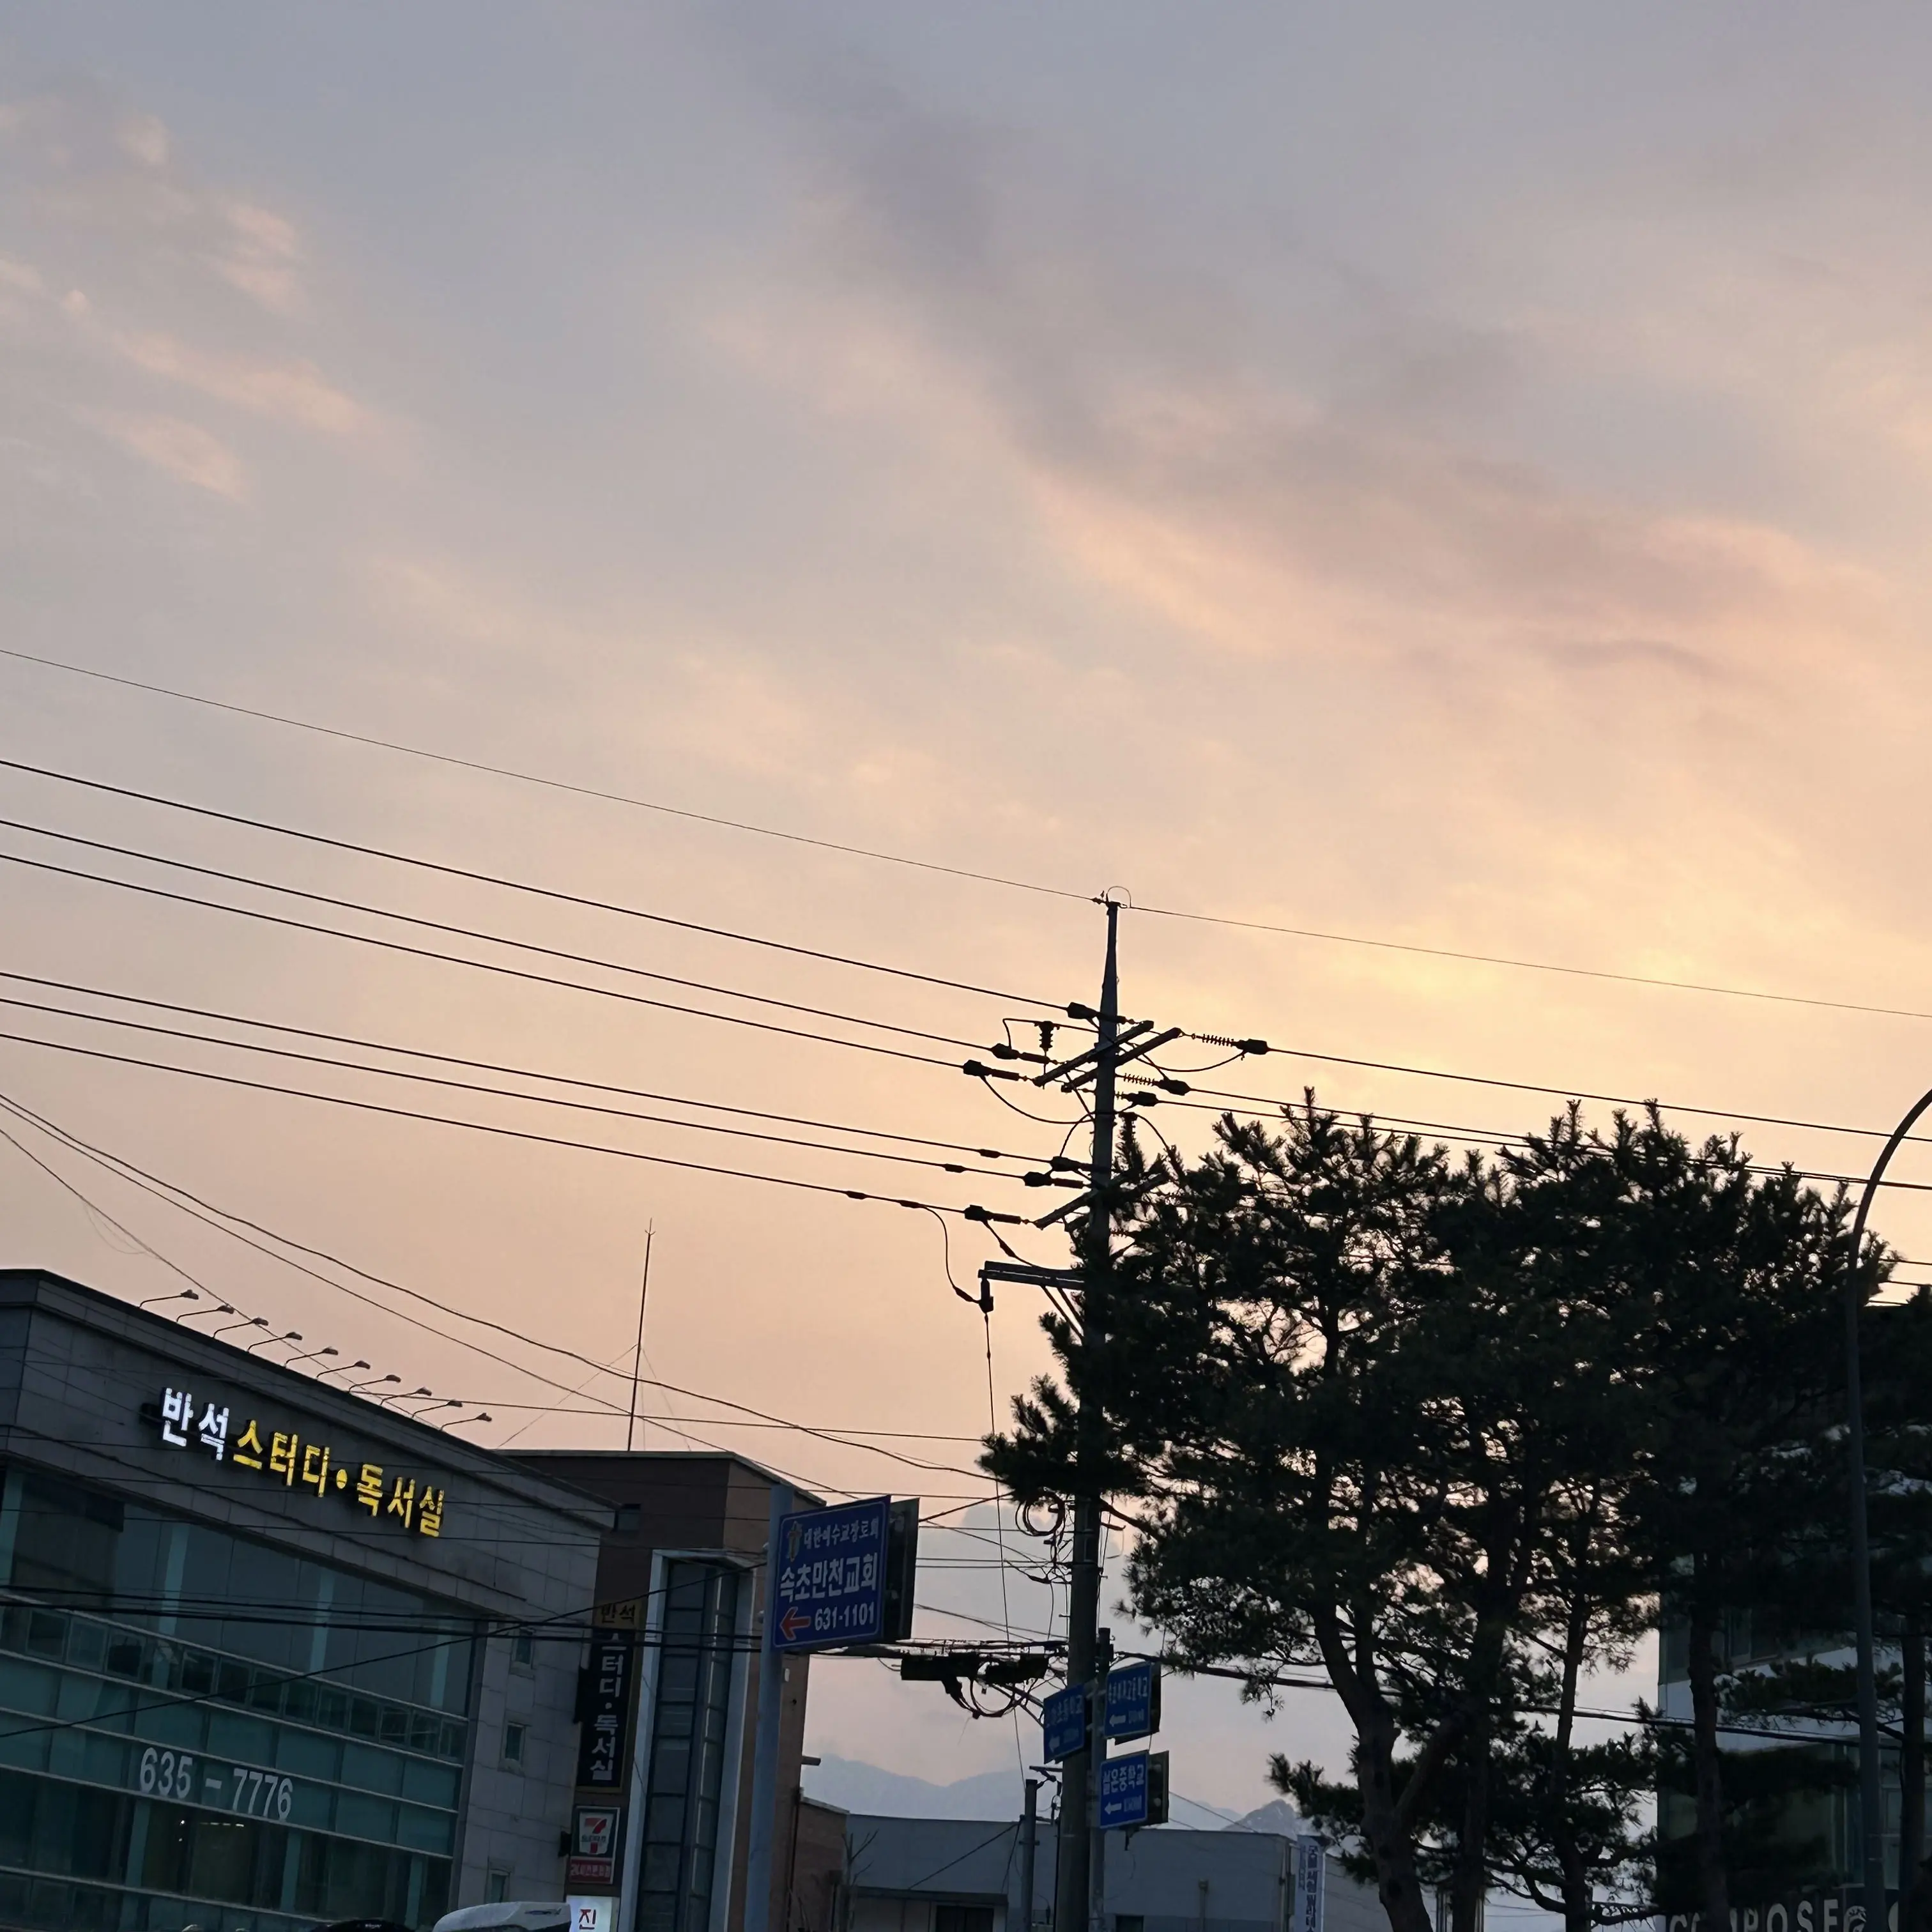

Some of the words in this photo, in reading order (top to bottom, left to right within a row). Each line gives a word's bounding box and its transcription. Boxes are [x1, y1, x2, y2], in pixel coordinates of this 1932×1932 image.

[162, 1388, 229, 1461] 반석
[779, 1552, 878, 1604] 속초만천교회
[601, 1604, 636, 1625] 반석
[815, 1602, 875, 1632] 631-1101
[139, 1747, 194, 1800] 635
[233, 1767, 294, 1821] 7776
